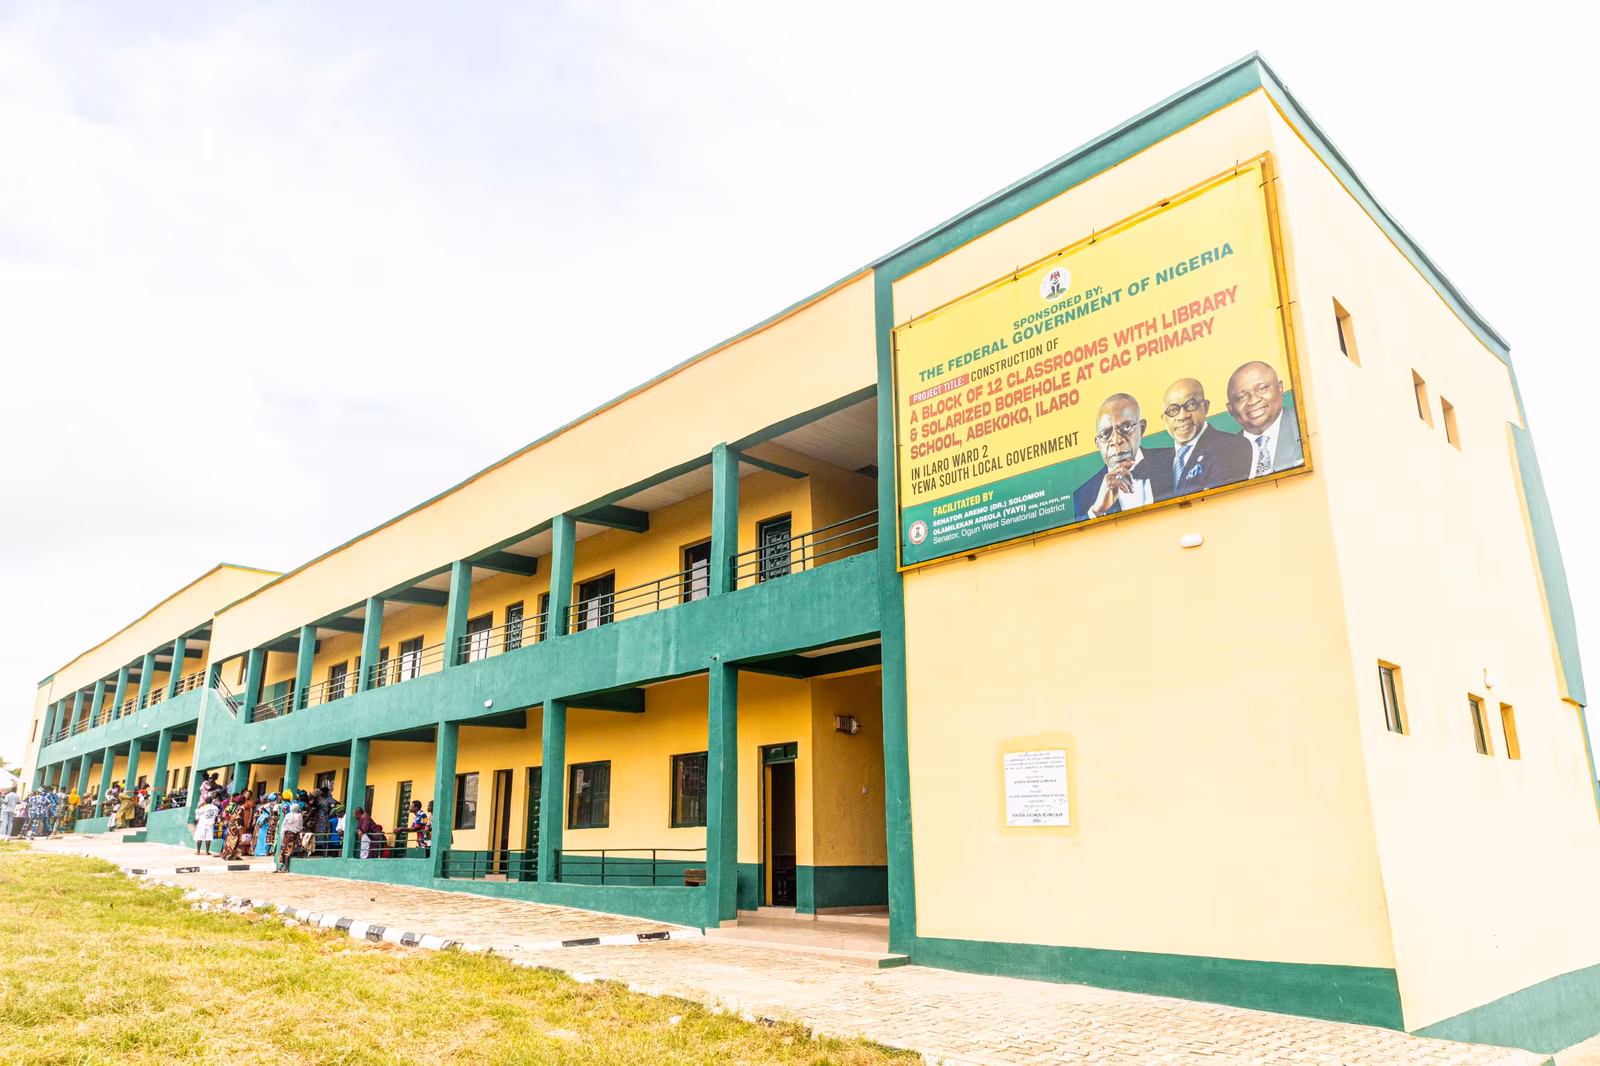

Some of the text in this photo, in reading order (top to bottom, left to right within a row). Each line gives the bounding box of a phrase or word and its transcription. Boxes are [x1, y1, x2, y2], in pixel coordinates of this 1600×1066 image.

[918, 242, 1234, 382] THE FEDERAL GOVERNMENT OF NIGERIA
[1013, 286, 1103, 330] SPONSORED BY:
[910, 285, 1238, 425] A BLOCK OF 12 CLASSROOMS WITH LIBRARY
[910, 316, 1214, 442] & SOLARIZED BOREHOLE AT CAC PRIMARY
[913, 338, 1059, 403] PROJECT TITLE: CONSTRUCTION OF
[910, 393, 1080, 460] SCHOOL, ABEKOKO, ILARO
[911, 444, 988, 481] IN ILARO WARD 2
[911, 432, 1079, 495] YEWA SOUTH LOCAL GOVERNMENT
[933, 490, 994, 516] FACILITATED BY
[933, 490, 1045, 526] SENATOR AREMO (DR.) SOLOMON
[933, 520, 973, 535] OLAMILEKAN
[975, 512, 1001, 524] ADEOLA
[1003, 504, 1026, 517] (YAYI)
[933, 532, 959, 544] Senator,
[961, 527, 980, 536] Ogun
[982, 521, 999, 531] West
[1000, 510, 1037, 526] Senatorial
[1039, 503, 1065, 516] District
